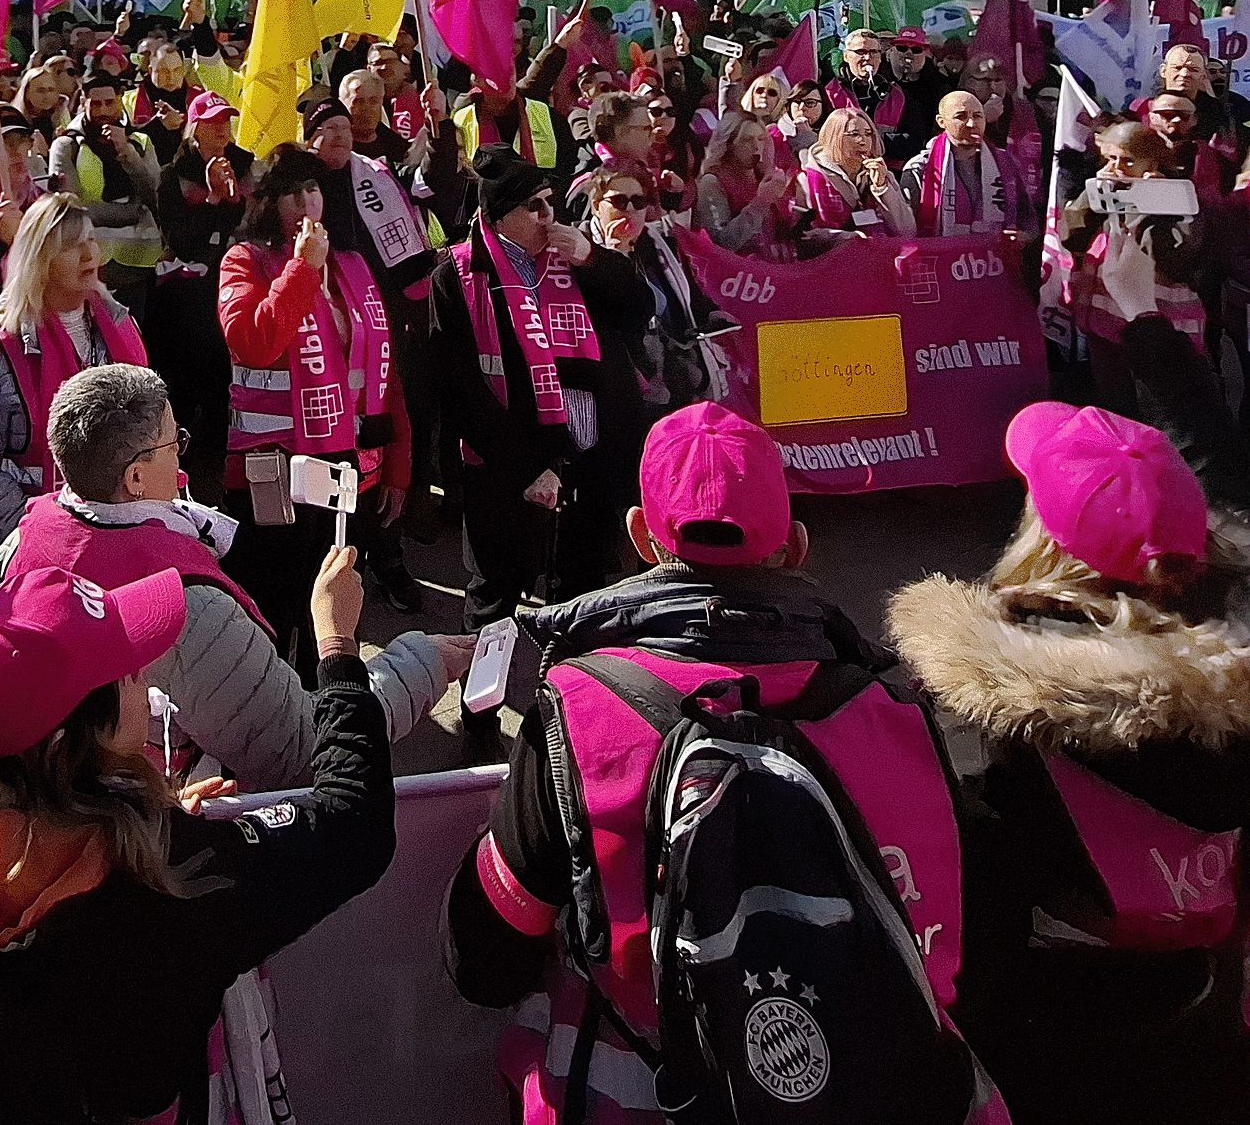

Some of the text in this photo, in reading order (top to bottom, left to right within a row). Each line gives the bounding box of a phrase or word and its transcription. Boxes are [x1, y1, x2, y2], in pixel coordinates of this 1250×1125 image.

[354, 178, 384, 214] dbb
[951, 250, 1004, 281] dbb
[720, 271, 776, 304] dbb
[519, 295, 550, 349] dbb
[915, 335, 1022, 373] sind wir
[748, 1004, 816, 1046] FC BAYERN
